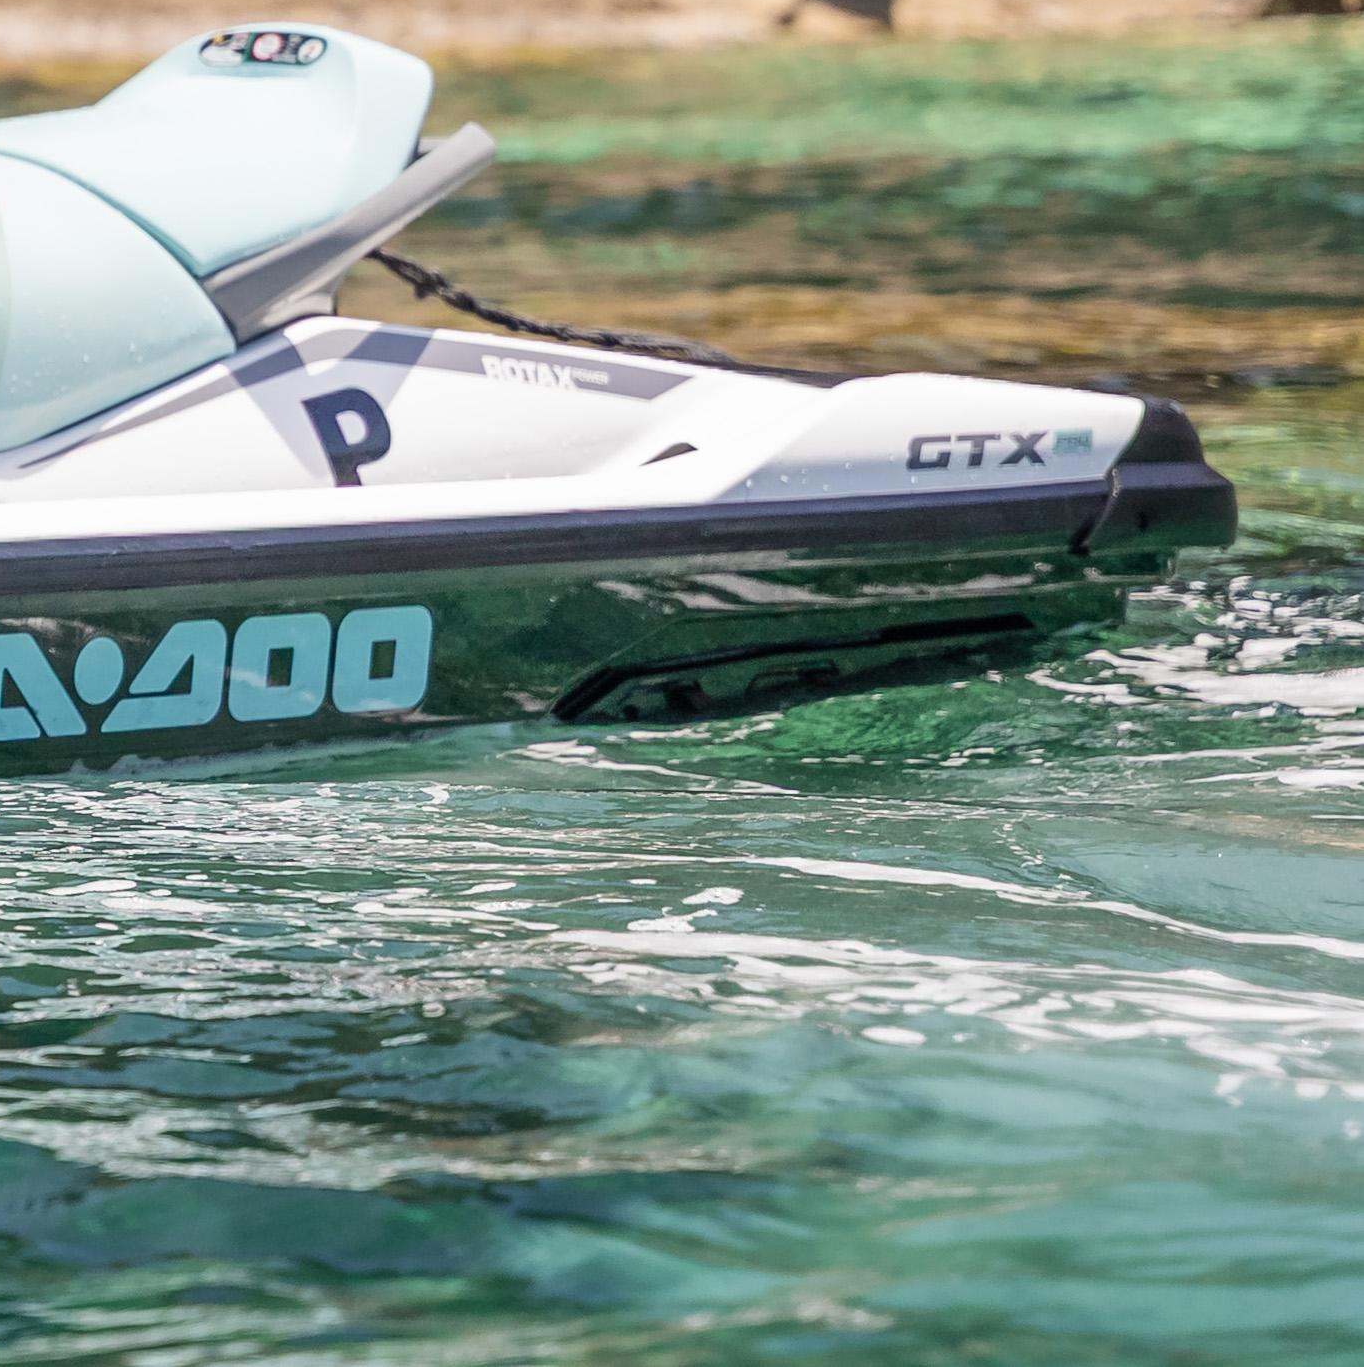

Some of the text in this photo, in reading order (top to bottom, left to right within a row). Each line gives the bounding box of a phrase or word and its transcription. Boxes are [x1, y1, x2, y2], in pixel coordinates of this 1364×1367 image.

[481, 354, 576, 390] ROTAX
[300, 387, 391, 487] P
[905, 430, 1048, 470] GTX
